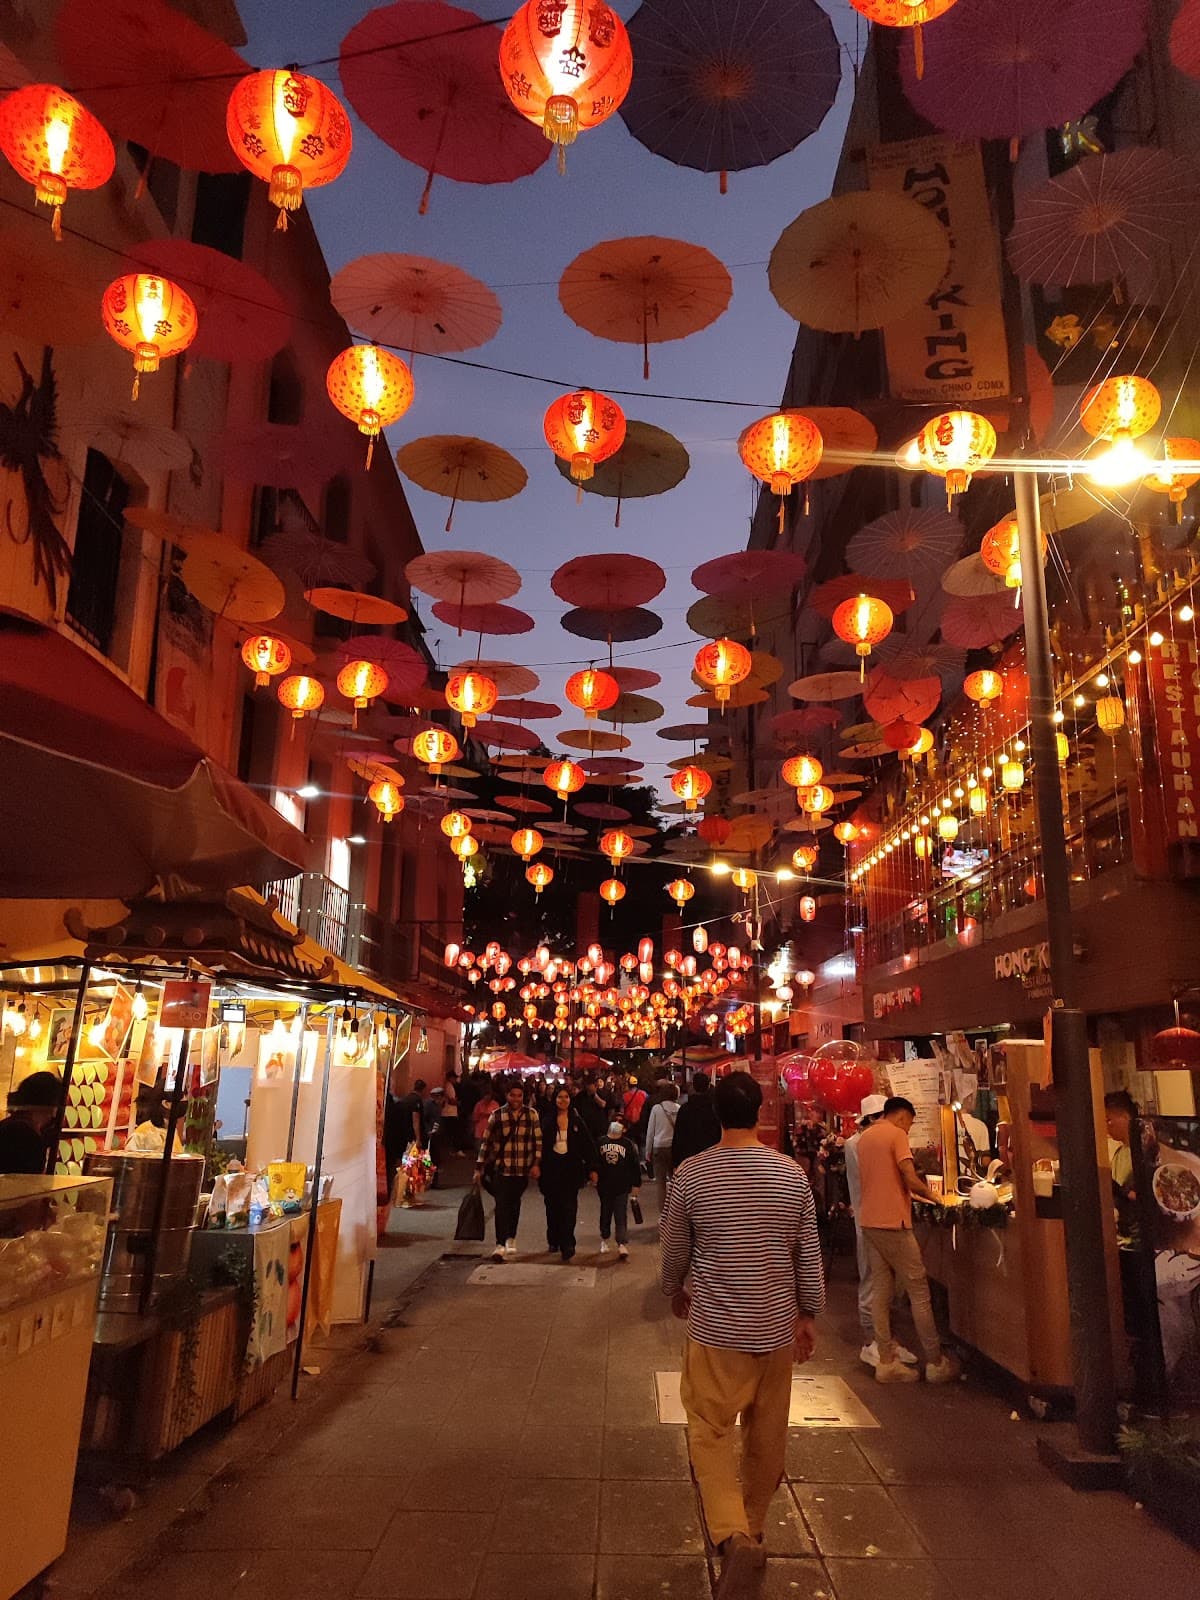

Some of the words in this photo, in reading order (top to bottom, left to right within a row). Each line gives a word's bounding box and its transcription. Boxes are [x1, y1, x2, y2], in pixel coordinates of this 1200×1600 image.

[941, 382, 972, 394] CHINO
[977, 380, 1005, 391] CDMX
[1161, 643, 1198, 837] RESTAURAN
